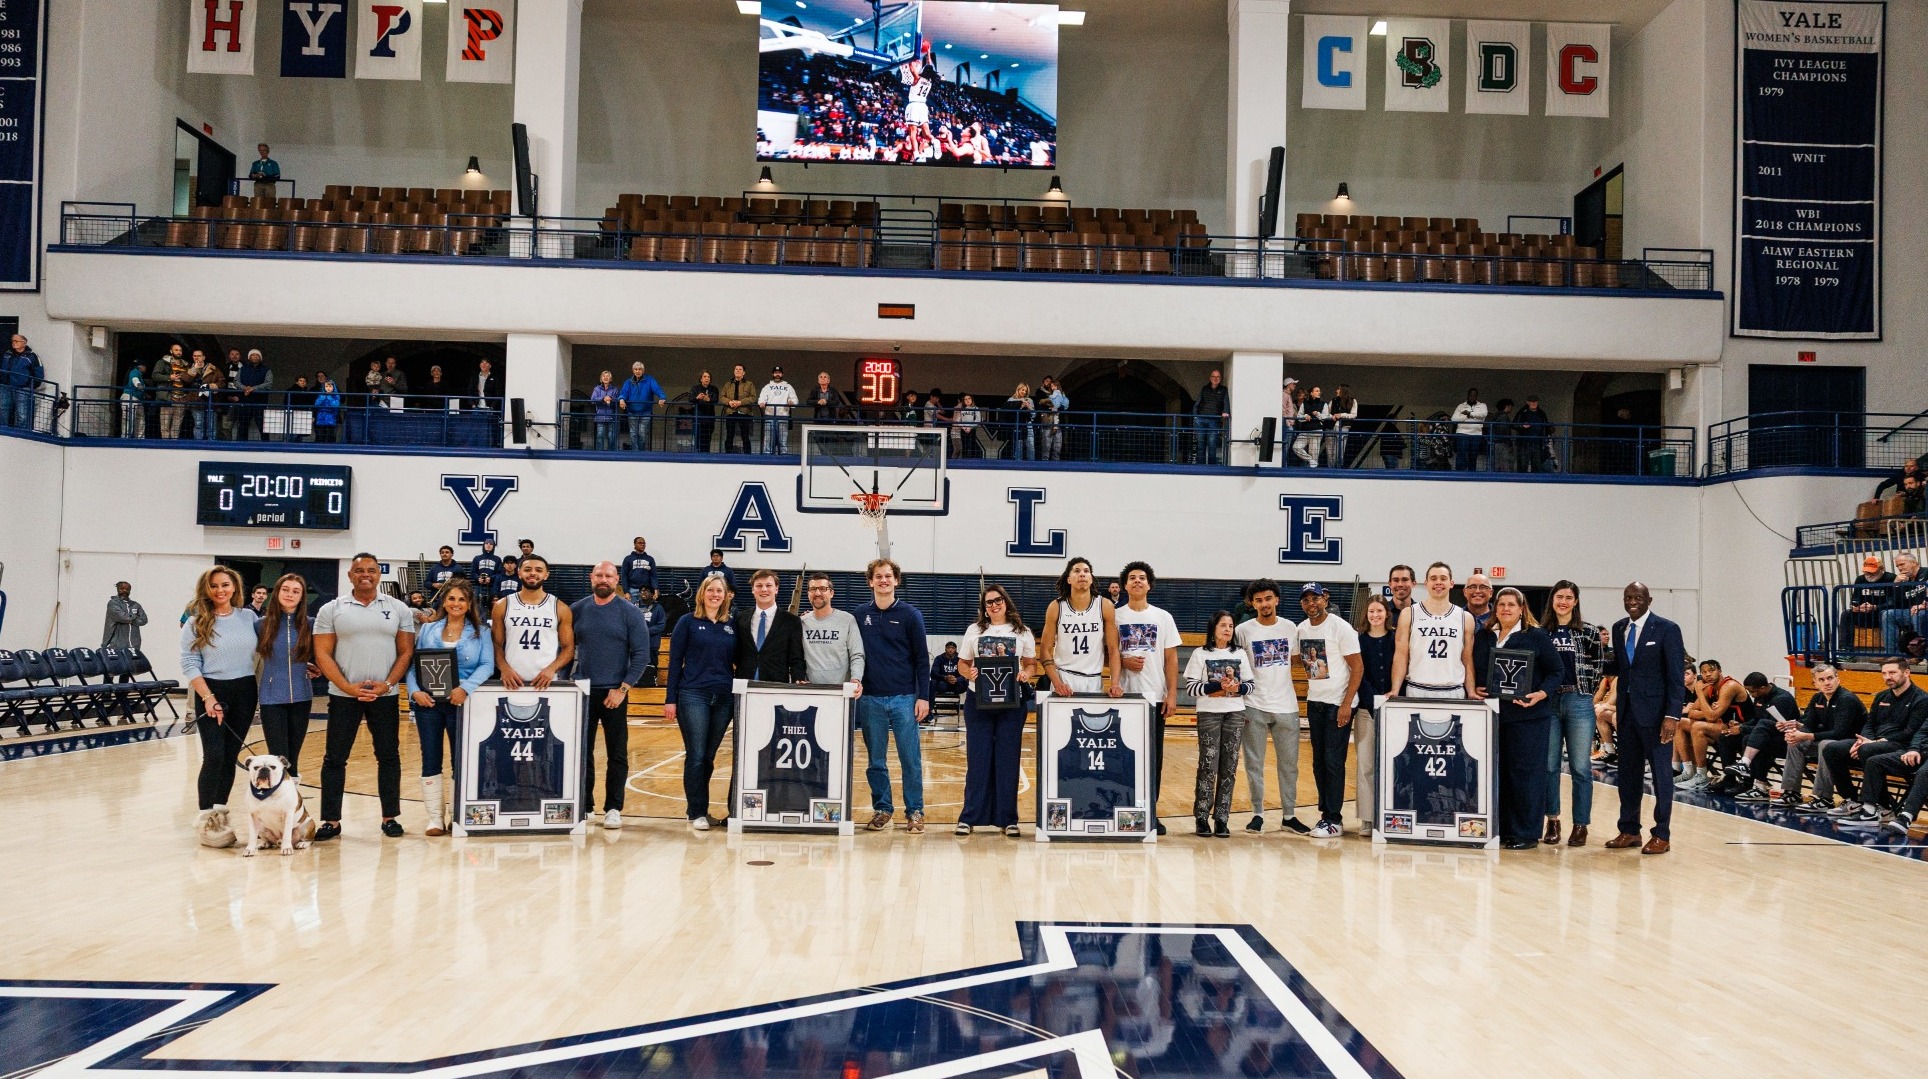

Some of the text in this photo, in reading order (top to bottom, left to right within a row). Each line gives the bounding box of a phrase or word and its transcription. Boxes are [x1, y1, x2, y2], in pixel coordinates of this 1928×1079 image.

[202, 0, 243, 52] H
[1780, 12, 1842, 29] YALE
[1, 29, 20, 38] 981
[289, 2, 342, 56] Y
[369, 5, 412, 58] P
[461, 8, 504, 61] P
[1746, 32, 1876, 45] WOMEN'S BASKETBALL
[0, 43, 21, 52] 986
[0, 58, 20, 67] 993
[1317, 35, 1353, 88] C
[1478, 41, 1519, 93] D
[1774, 59, 1846, 70] IVY LEAGUE
[1558, 43, 1599, 95] C
[1773, 71, 1847, 82] CHAMPIONS
[1759, 87, 1784, 96] 1979
[1792, 153, 1826, 163] WNIT
[1758, 166, 1782, 176] 2011
[1796, 210, 1820, 219] WBI
[1755, 219, 1862, 232] 2018 CHAMPIONS
[1762, 246, 1854, 258] AIAW EASTERN
[1776, 260, 1839, 271] REGIONAL
[1775, 276, 1839, 287] 1978 1979
[865, 362, 891, 373] 20:00
[862, 374, 894, 401] 30
[241, 475, 302, 497] 20:00
[220, 489, 233, 510] 0
[328, 492, 341, 513] 0
[257, 513, 284, 523] period
[269, 538, 281, 548] EXIT
[1493, 567, 1504, 576] EXIT
[381, 611, 390, 620] Y
[510, 617, 553, 628] YALE
[1062, 623, 1098, 633] YALE
[806, 629, 839, 640] YALE
[1418, 627, 1457, 638] YALE
[519, 630, 540, 649] 44
[1072, 636, 1089, 654] 14
[1428, 640, 1447, 658] 42
[420, 658, 451, 690] Y
[1495, 658, 1527, 689] Y
[981, 667, 1012, 696] Y
[501, 728, 544, 738] YALE
[782, 726, 807, 735] THIEL
[1076, 738, 1116, 748] YALE
[511, 741, 533, 761] 44
[776, 738, 811, 769] 20
[1415, 745, 1455, 755] YALE
[1088, 751, 1104, 770] 14
[1425, 757, 1446, 776] 42
